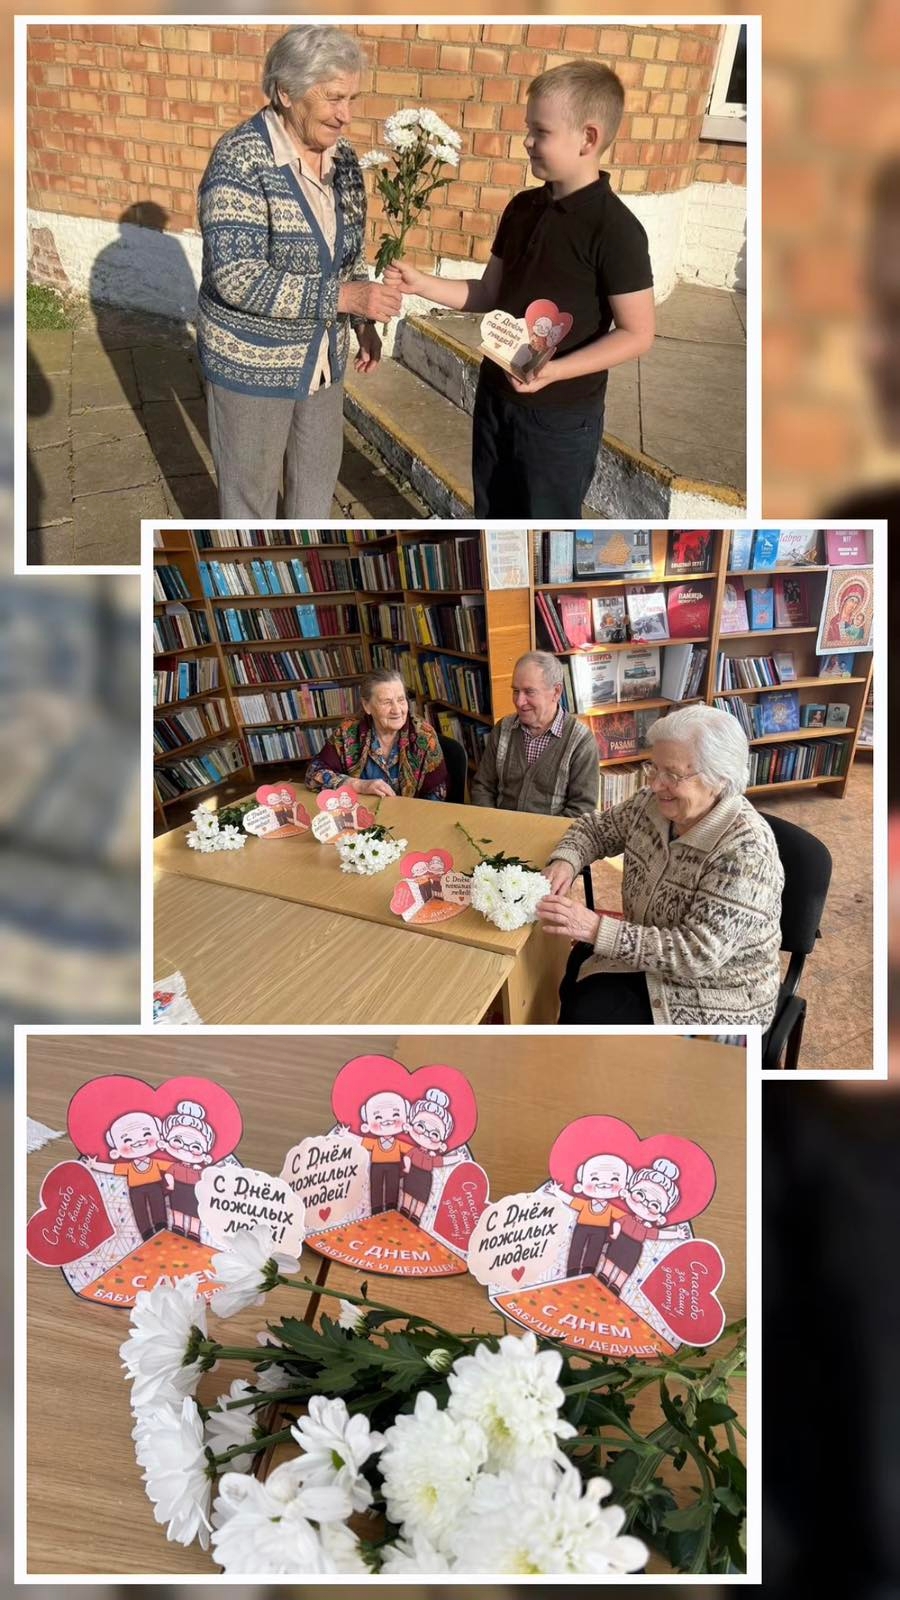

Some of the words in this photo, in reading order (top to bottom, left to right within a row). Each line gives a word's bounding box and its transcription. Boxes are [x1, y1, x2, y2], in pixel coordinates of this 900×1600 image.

[291, 1153, 301, 1174] С
[306, 1144, 353, 1170] Днём
[213, 1175, 226, 1193] С
[234, 1176, 286, 1204] Днём
[288, 1164, 359, 1192] пожилых
[41, 1186, 74, 1245] Спасибо
[67, 1194, 89, 1223] вашу
[78, 1194, 99, 1249] доброту!
[209, 1196, 294, 1225] пожилых
[486, 1210, 498, 1232] С
[502, 1201, 556, 1226] Днём
[66, 1227, 76, 1243] за
[478, 1222, 558, 1253] пожилых
[315, 1241, 376, 1269] БАБУШЕК
[378, 1263, 389, 1271] И
[392, 1263, 457, 1274] ДЕДУШЕК
[348, 1240, 364, 1251] С
[364, 1245, 432, 1261] ДНЕМ
[488, 1239, 548, 1271] людей!
[131, 1275, 148, 1288] С
[674, 1268, 686, 1283] за
[690, 1261, 708, 1320] Спасибо
[661, 1265, 677, 1318] доброту!
[674, 1287, 690, 1316] вашу
[506, 1302, 569, 1341] БАБУШЕК
[573, 1335, 585, 1345] И
[588, 1339, 660, 1354] ДЕДУШЕК
[541, 1305, 558, 1317] С
[558, 1313, 632, 1339] ДНЕМ
